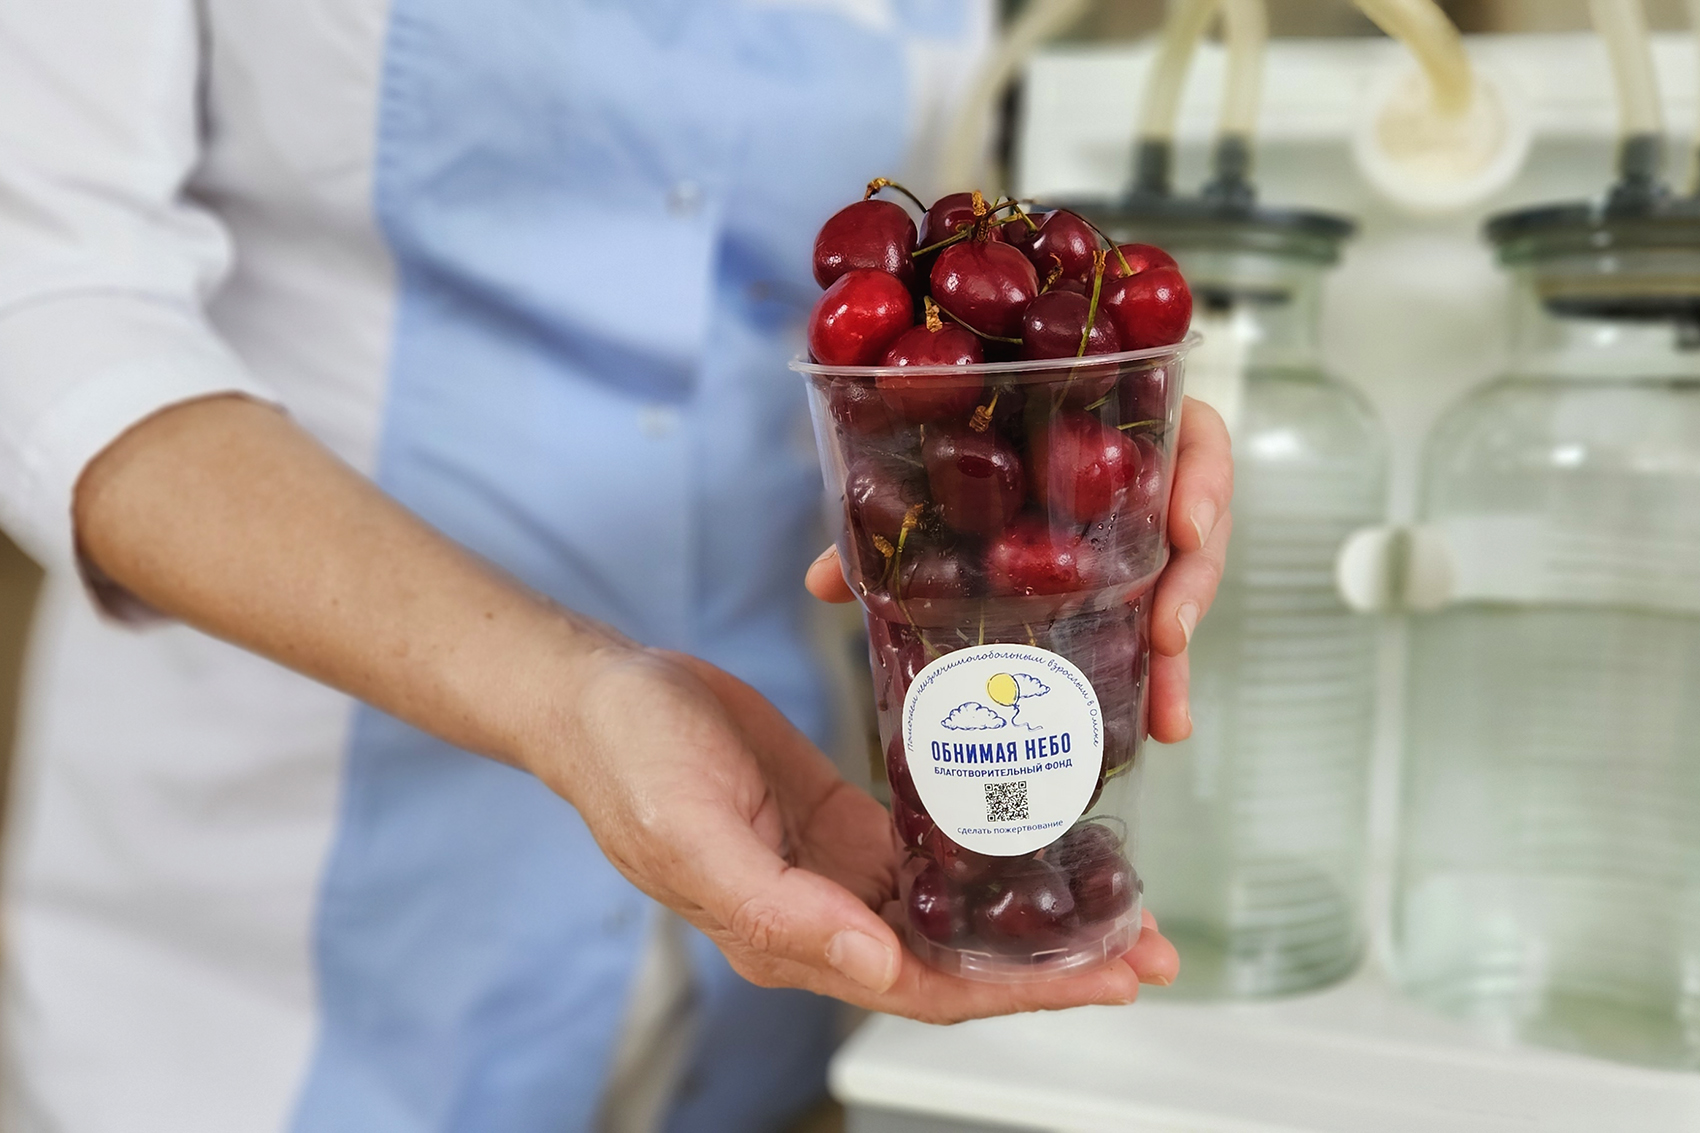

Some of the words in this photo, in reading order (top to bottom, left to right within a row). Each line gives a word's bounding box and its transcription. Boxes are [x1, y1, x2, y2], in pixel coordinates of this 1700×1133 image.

[1047, 659, 1089, 700] взрослым
[1089, 708, 1099, 748] Омске
[931, 740, 1018, 764] ОБНИМАЯ
[1025, 732, 1071, 760] НЕБО
[934, 763, 1043, 778] БЛАГОТВОРИТЕЛЬНЫЙ
[1044, 758, 1073, 771] ФОНД
[957, 827, 992, 835] сделать
[993, 820, 1064, 835] пожертвование
